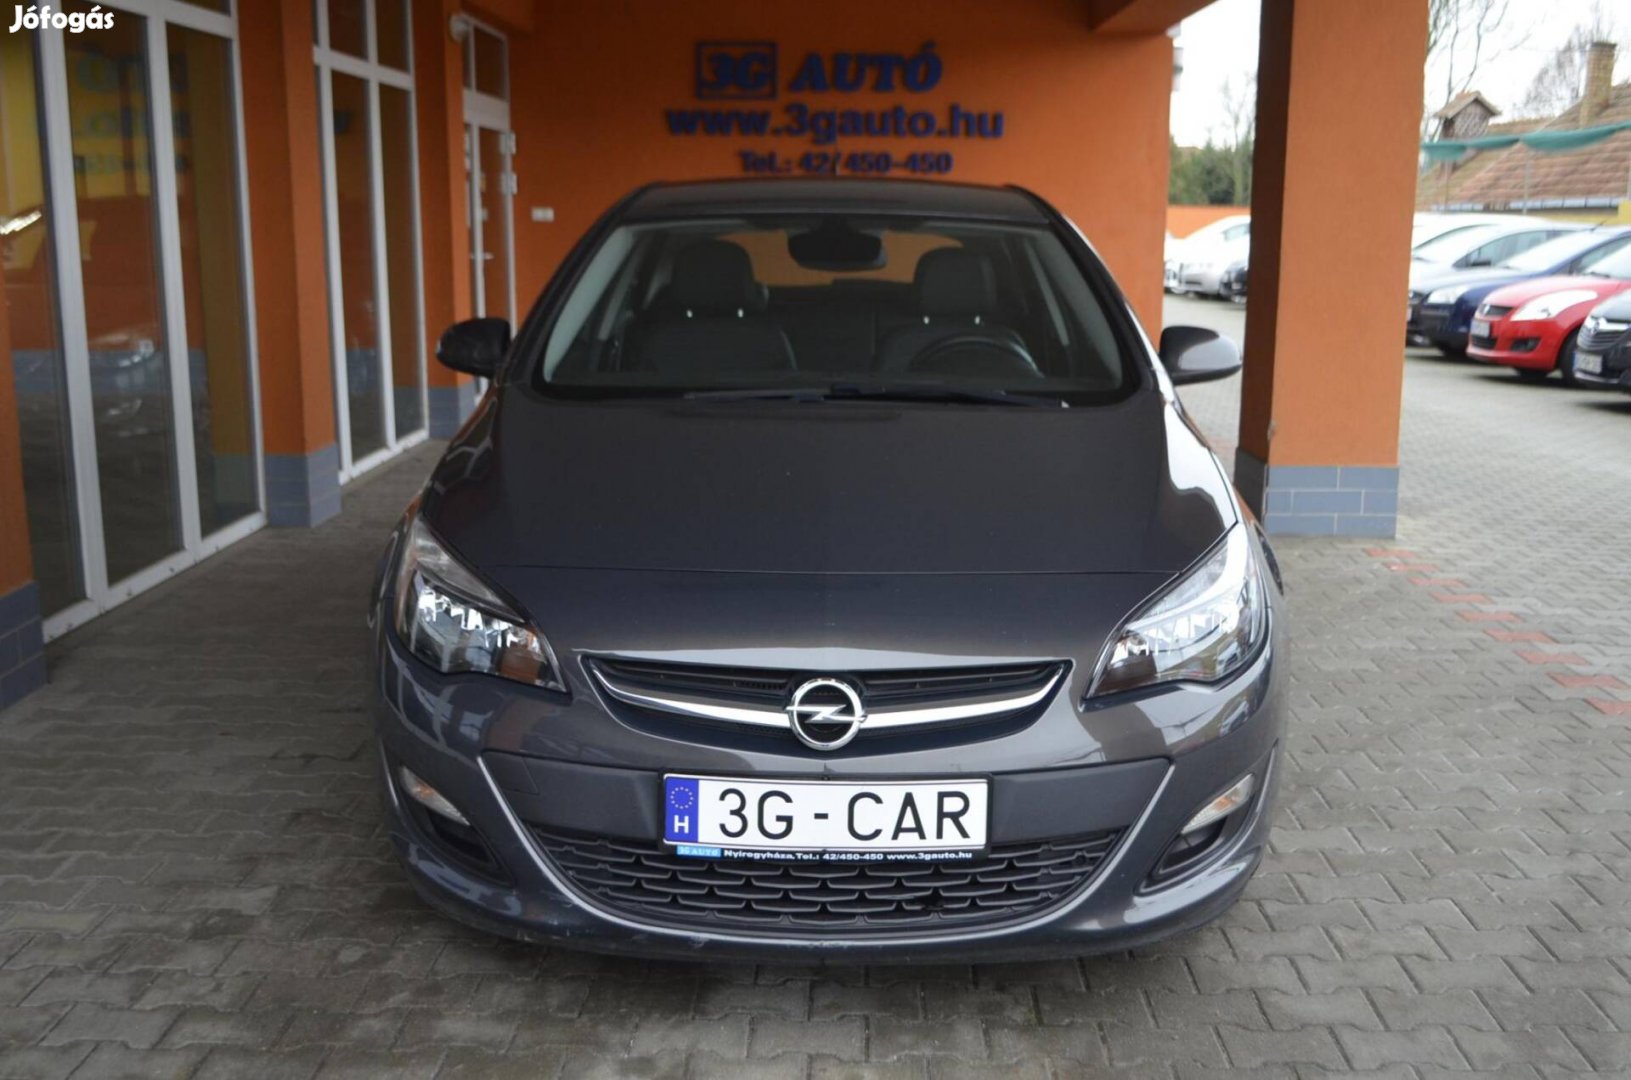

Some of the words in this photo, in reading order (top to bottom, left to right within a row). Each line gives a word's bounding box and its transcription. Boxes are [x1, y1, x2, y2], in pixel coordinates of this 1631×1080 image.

[703, 50, 770, 91] 3G
[788, 40, 943, 93] AUTÓ
[664, 103, 1004, 144] www.3gauto.hu
[673, 814, 690, 834] H
[822, 852, 884, 861] 42/450-450
[886, 851, 973, 862] www.3gauto.hu
